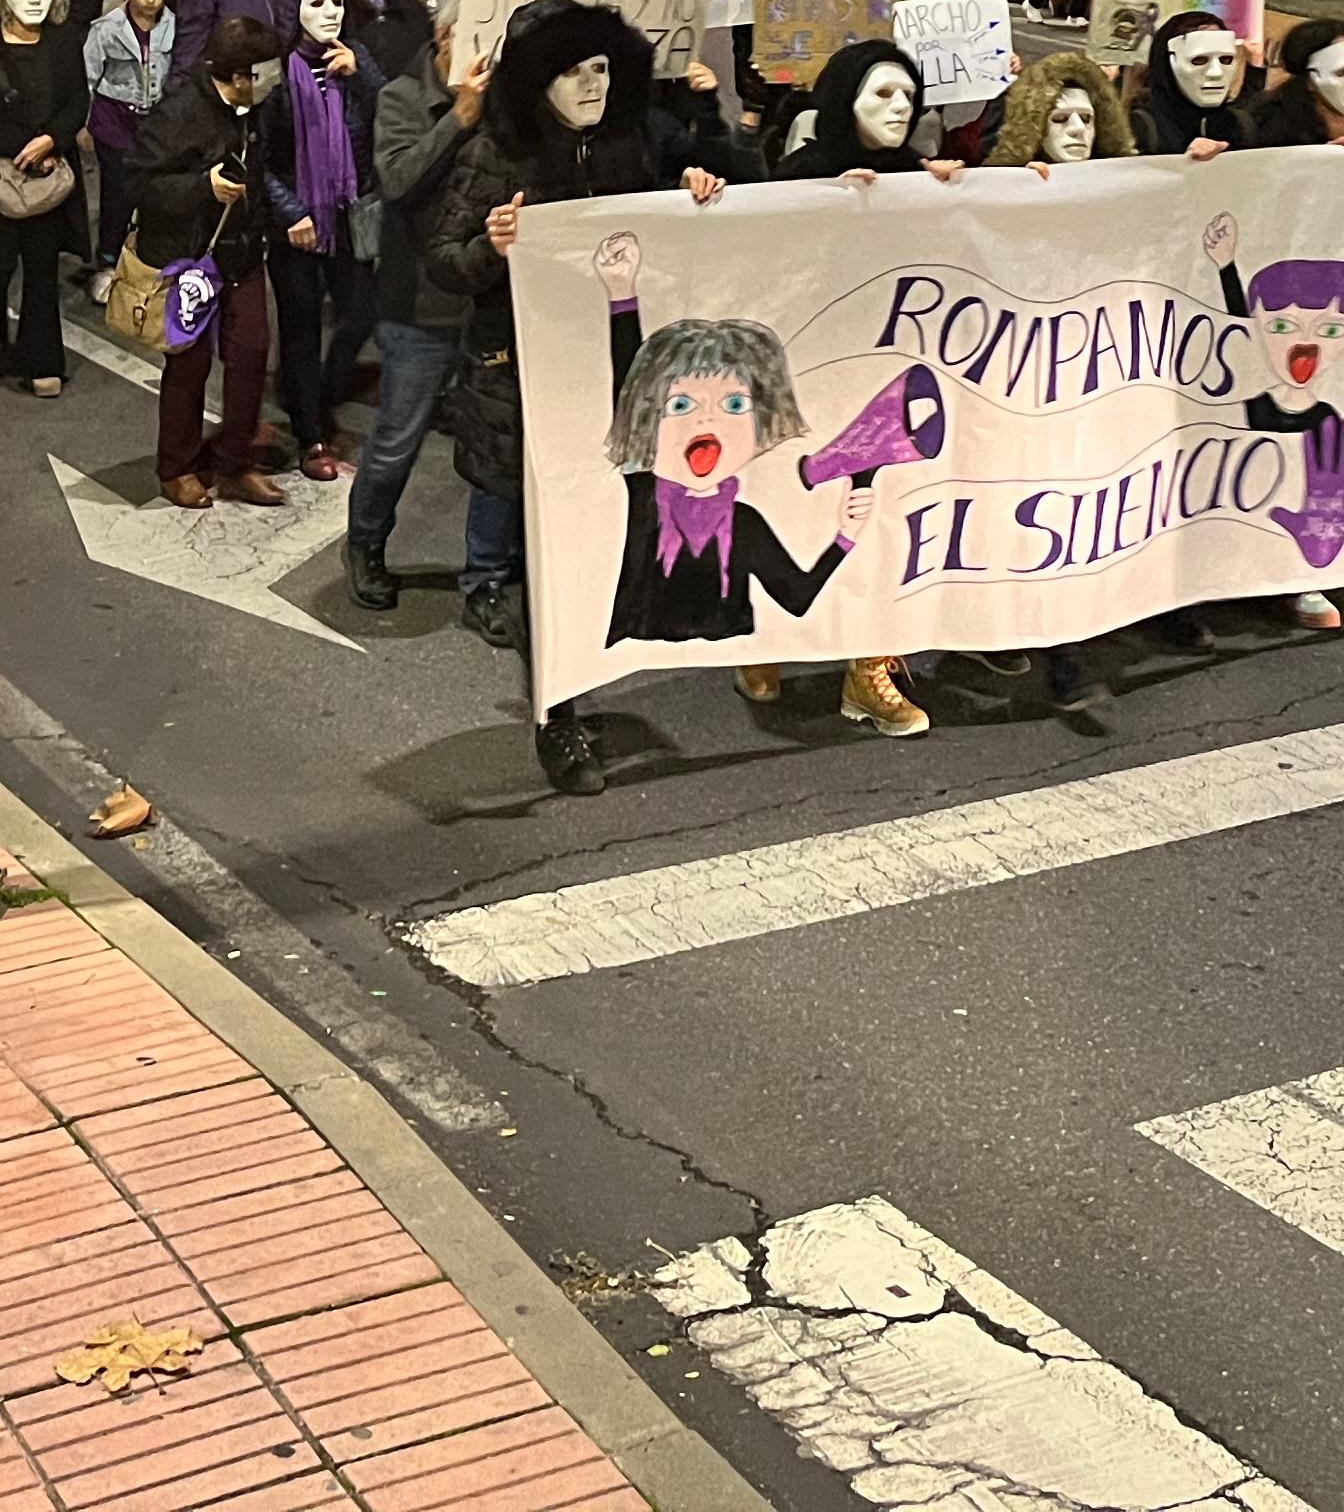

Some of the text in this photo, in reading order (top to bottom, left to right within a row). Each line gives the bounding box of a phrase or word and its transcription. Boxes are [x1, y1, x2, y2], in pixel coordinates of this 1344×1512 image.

[915, 40, 948, 64] POR
[875, 276, 1252, 409] ROMPAMOS
[900, 496, 988, 586] EL
[1007, 437, 1287, 575] SILENCIO
